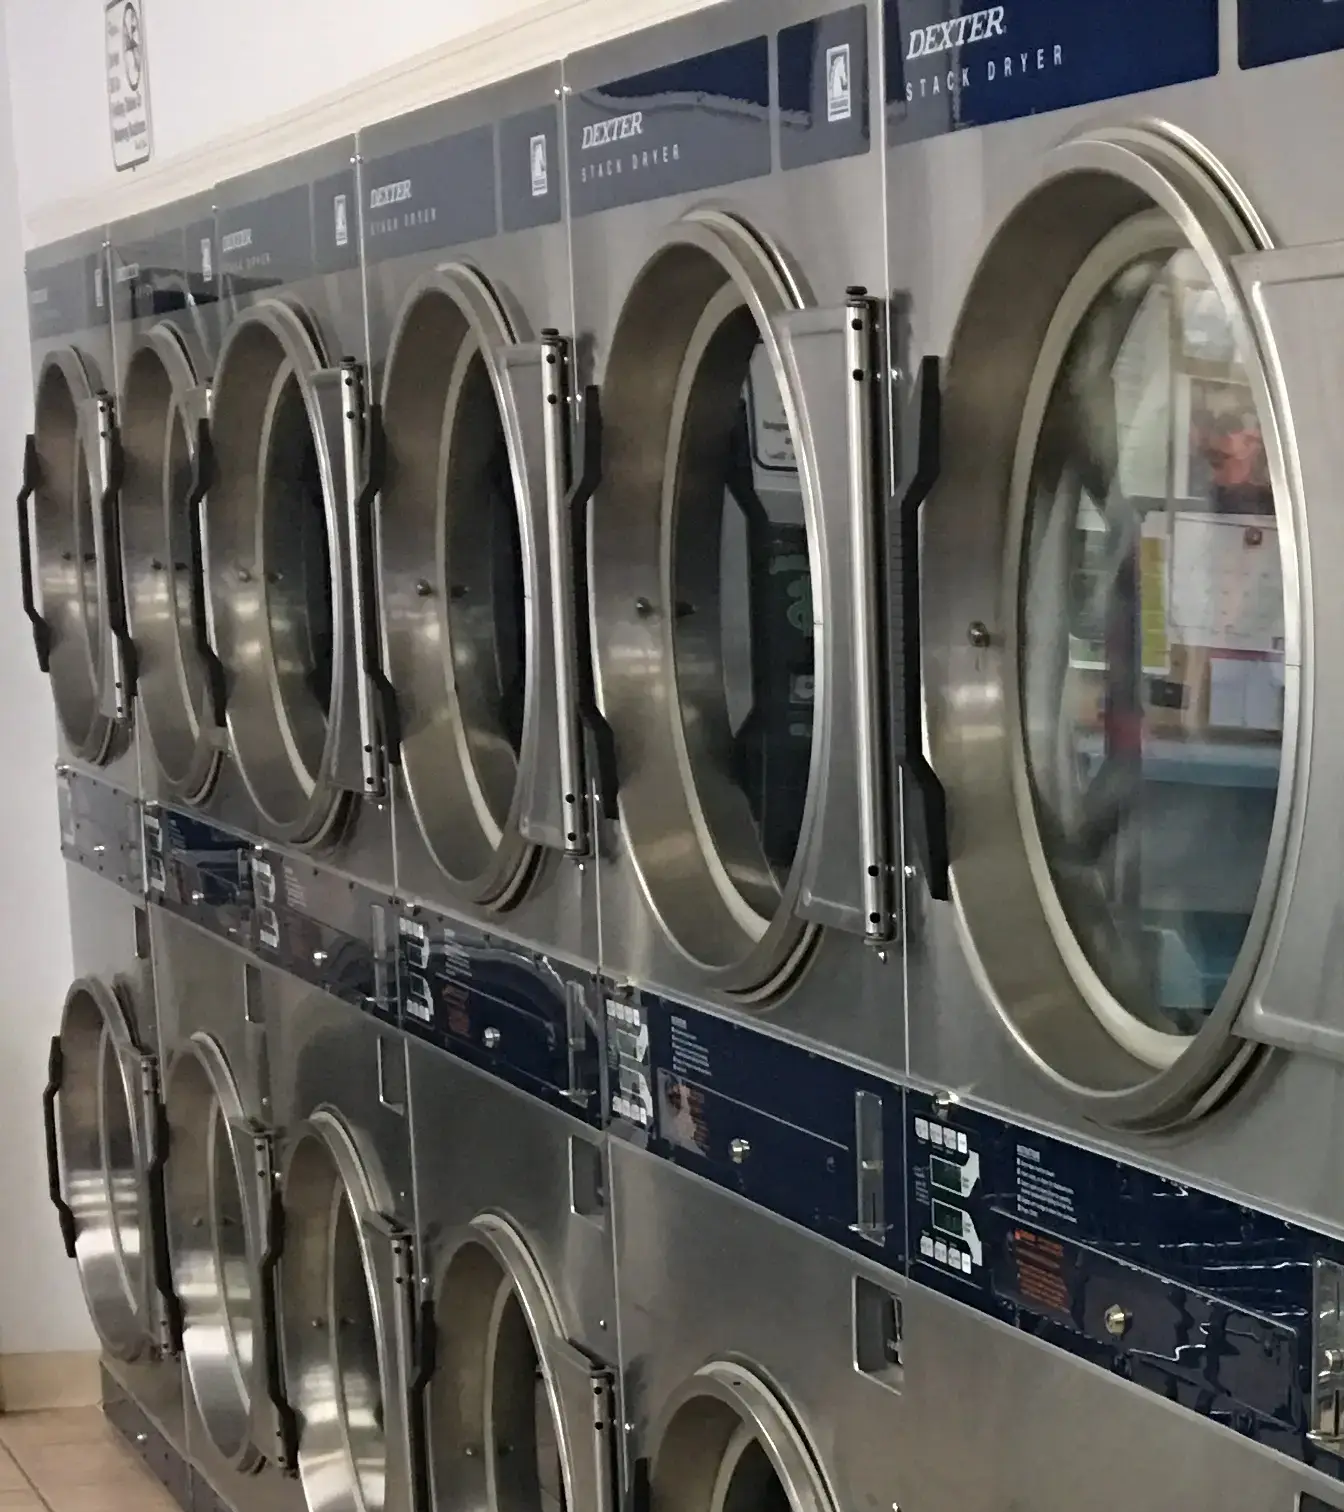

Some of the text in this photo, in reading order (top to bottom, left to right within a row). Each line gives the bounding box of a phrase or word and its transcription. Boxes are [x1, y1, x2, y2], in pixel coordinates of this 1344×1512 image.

[906, 5, 1004, 60] DEXTER
[905, 44, 1062, 101] STACK DRYER
[581, 111, 643, 149] DEXTER
[632, 144, 680, 170] DRYER
